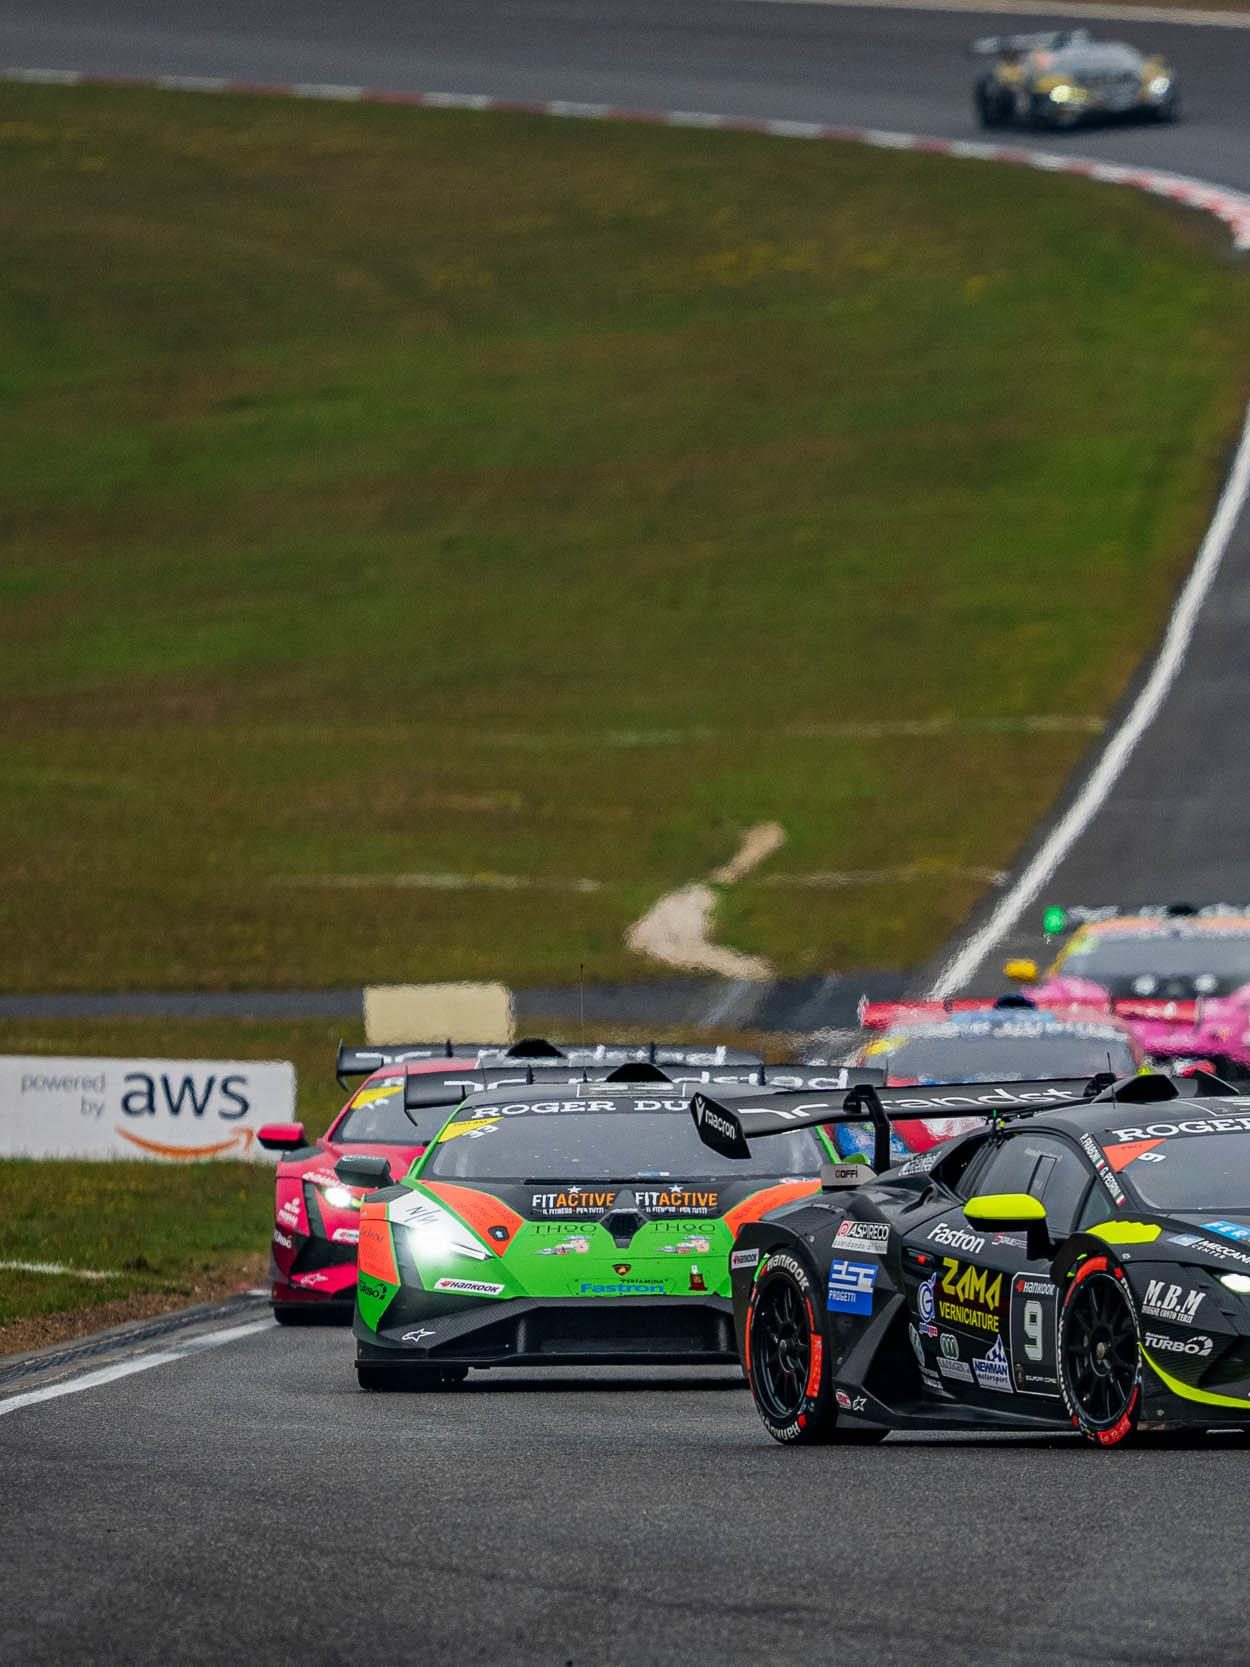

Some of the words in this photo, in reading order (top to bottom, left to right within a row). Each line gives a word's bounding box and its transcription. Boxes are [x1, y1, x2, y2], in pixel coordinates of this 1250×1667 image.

[21, 1073, 106, 1095] powered
[120, 1071, 250, 1120] aws
[81, 1096, 105, 1117] by
[472, 1101, 616, 1119] ROGER
[705, 1109, 736, 1140] macron
[635, 1191, 718, 1207] FITACTIVE
[847, 1223, 889, 1240] ASPIRECO
[926, 1222, 986, 1254] Fastron
[1191, 1244, 1227, 1260] CENTER
[580, 1282, 664, 1293] Fastron
[941, 1256, 1003, 1311] ZAMA
[828, 1290, 857, 1303] PROGETTI
[939, 1300, 1000, 1333] VERNICIATURE
[1024, 1300, 1044, 1361] 9
[1145, 1336, 1200, 1354] TURBO
[974, 1361, 1009, 1377] NEWMAN
